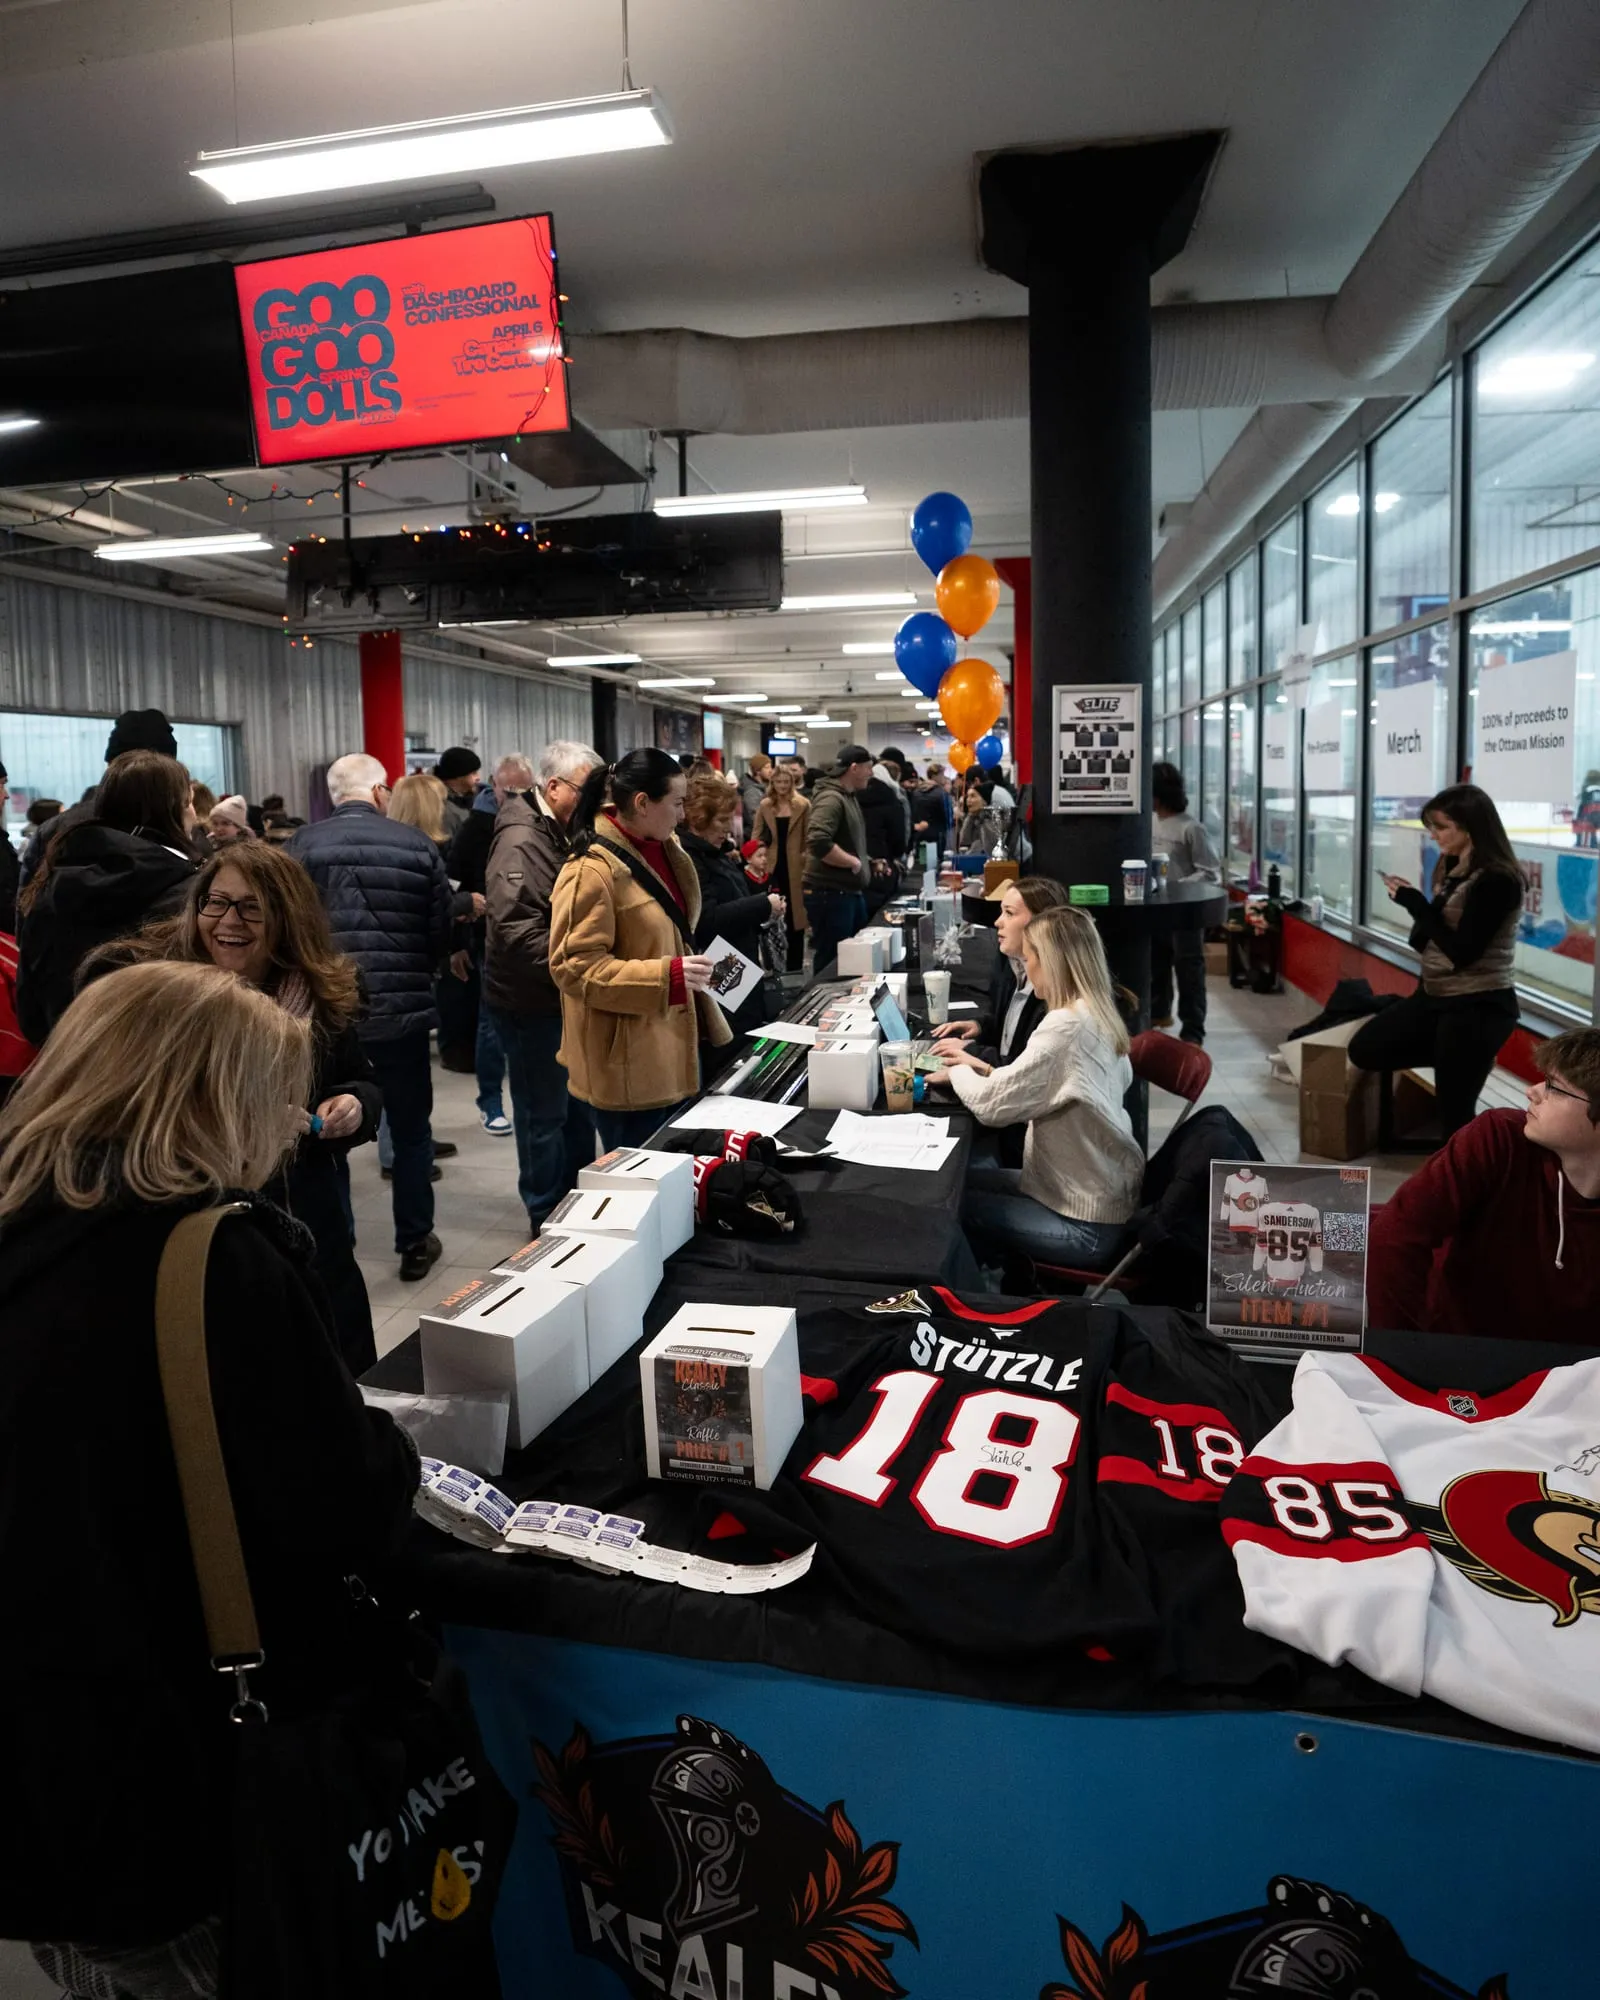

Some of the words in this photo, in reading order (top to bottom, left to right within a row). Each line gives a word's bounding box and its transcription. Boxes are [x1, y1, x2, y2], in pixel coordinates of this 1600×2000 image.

[253, 274, 391, 341] GOO
[402, 281, 517, 311] DASHBOARD
[405, 294, 541, 326] CONFESSIONAL
[259, 322, 321, 343] CANADA
[492, 323, 532, 338] APRIL
[533, 320, 543, 333] 6
[260, 322, 395, 386] GOO
[318, 366, 371, 384] SPRING
[266, 369, 403, 430] DOLLS
[1482, 714, 1503, 729] 100%
[1504, 710, 1513, 726] of
[1514, 705, 1556, 728] proceeds
[1557, 706, 1568, 720] to
[1387, 729, 1422, 754] Merch
[1484, 737, 1497, 753] the
[1498, 738, 1528, 752] Ottawa
[1529, 732, 1565, 749] Mission
[717, 962, 744, 994] KEALEY
[1264, 1215, 1313, 1228] SANDERSON
[1268, 1229, 1310, 1262] 85
[1222, 1272, 1278, 1295] Silent
[1283, 1277, 1346, 1298] Auction
[1241, 1297, 1293, 1325] ITEM
[1301, 1302, 1329, 1328] #1
[1223, 1327, 1258, 1338] SPONSORED
[1260, 1329, 1268, 1338] BY
[1270, 1330, 1310, 1341] FOREGROUND
[1312, 1333, 1345, 1343] EXTERIORS
[910, 1321, 1083, 1392] STÜTZLE
[681, 1379, 720, 1391] Classic
[1456, 1402, 1470, 1411] NHL
[687, 1426, 721, 1442] Raffle
[676, 1440, 714, 1460] PRIZE
[800, 1370, 1083, 1550] 18
[1150, 1416, 1247, 1487] 18
[667, 1471, 694, 1480] SIGNED
[1261, 1473, 1413, 1545] 85
[348, 1828, 393, 1882] YO
[581, 1880, 846, 2000] KEALE
